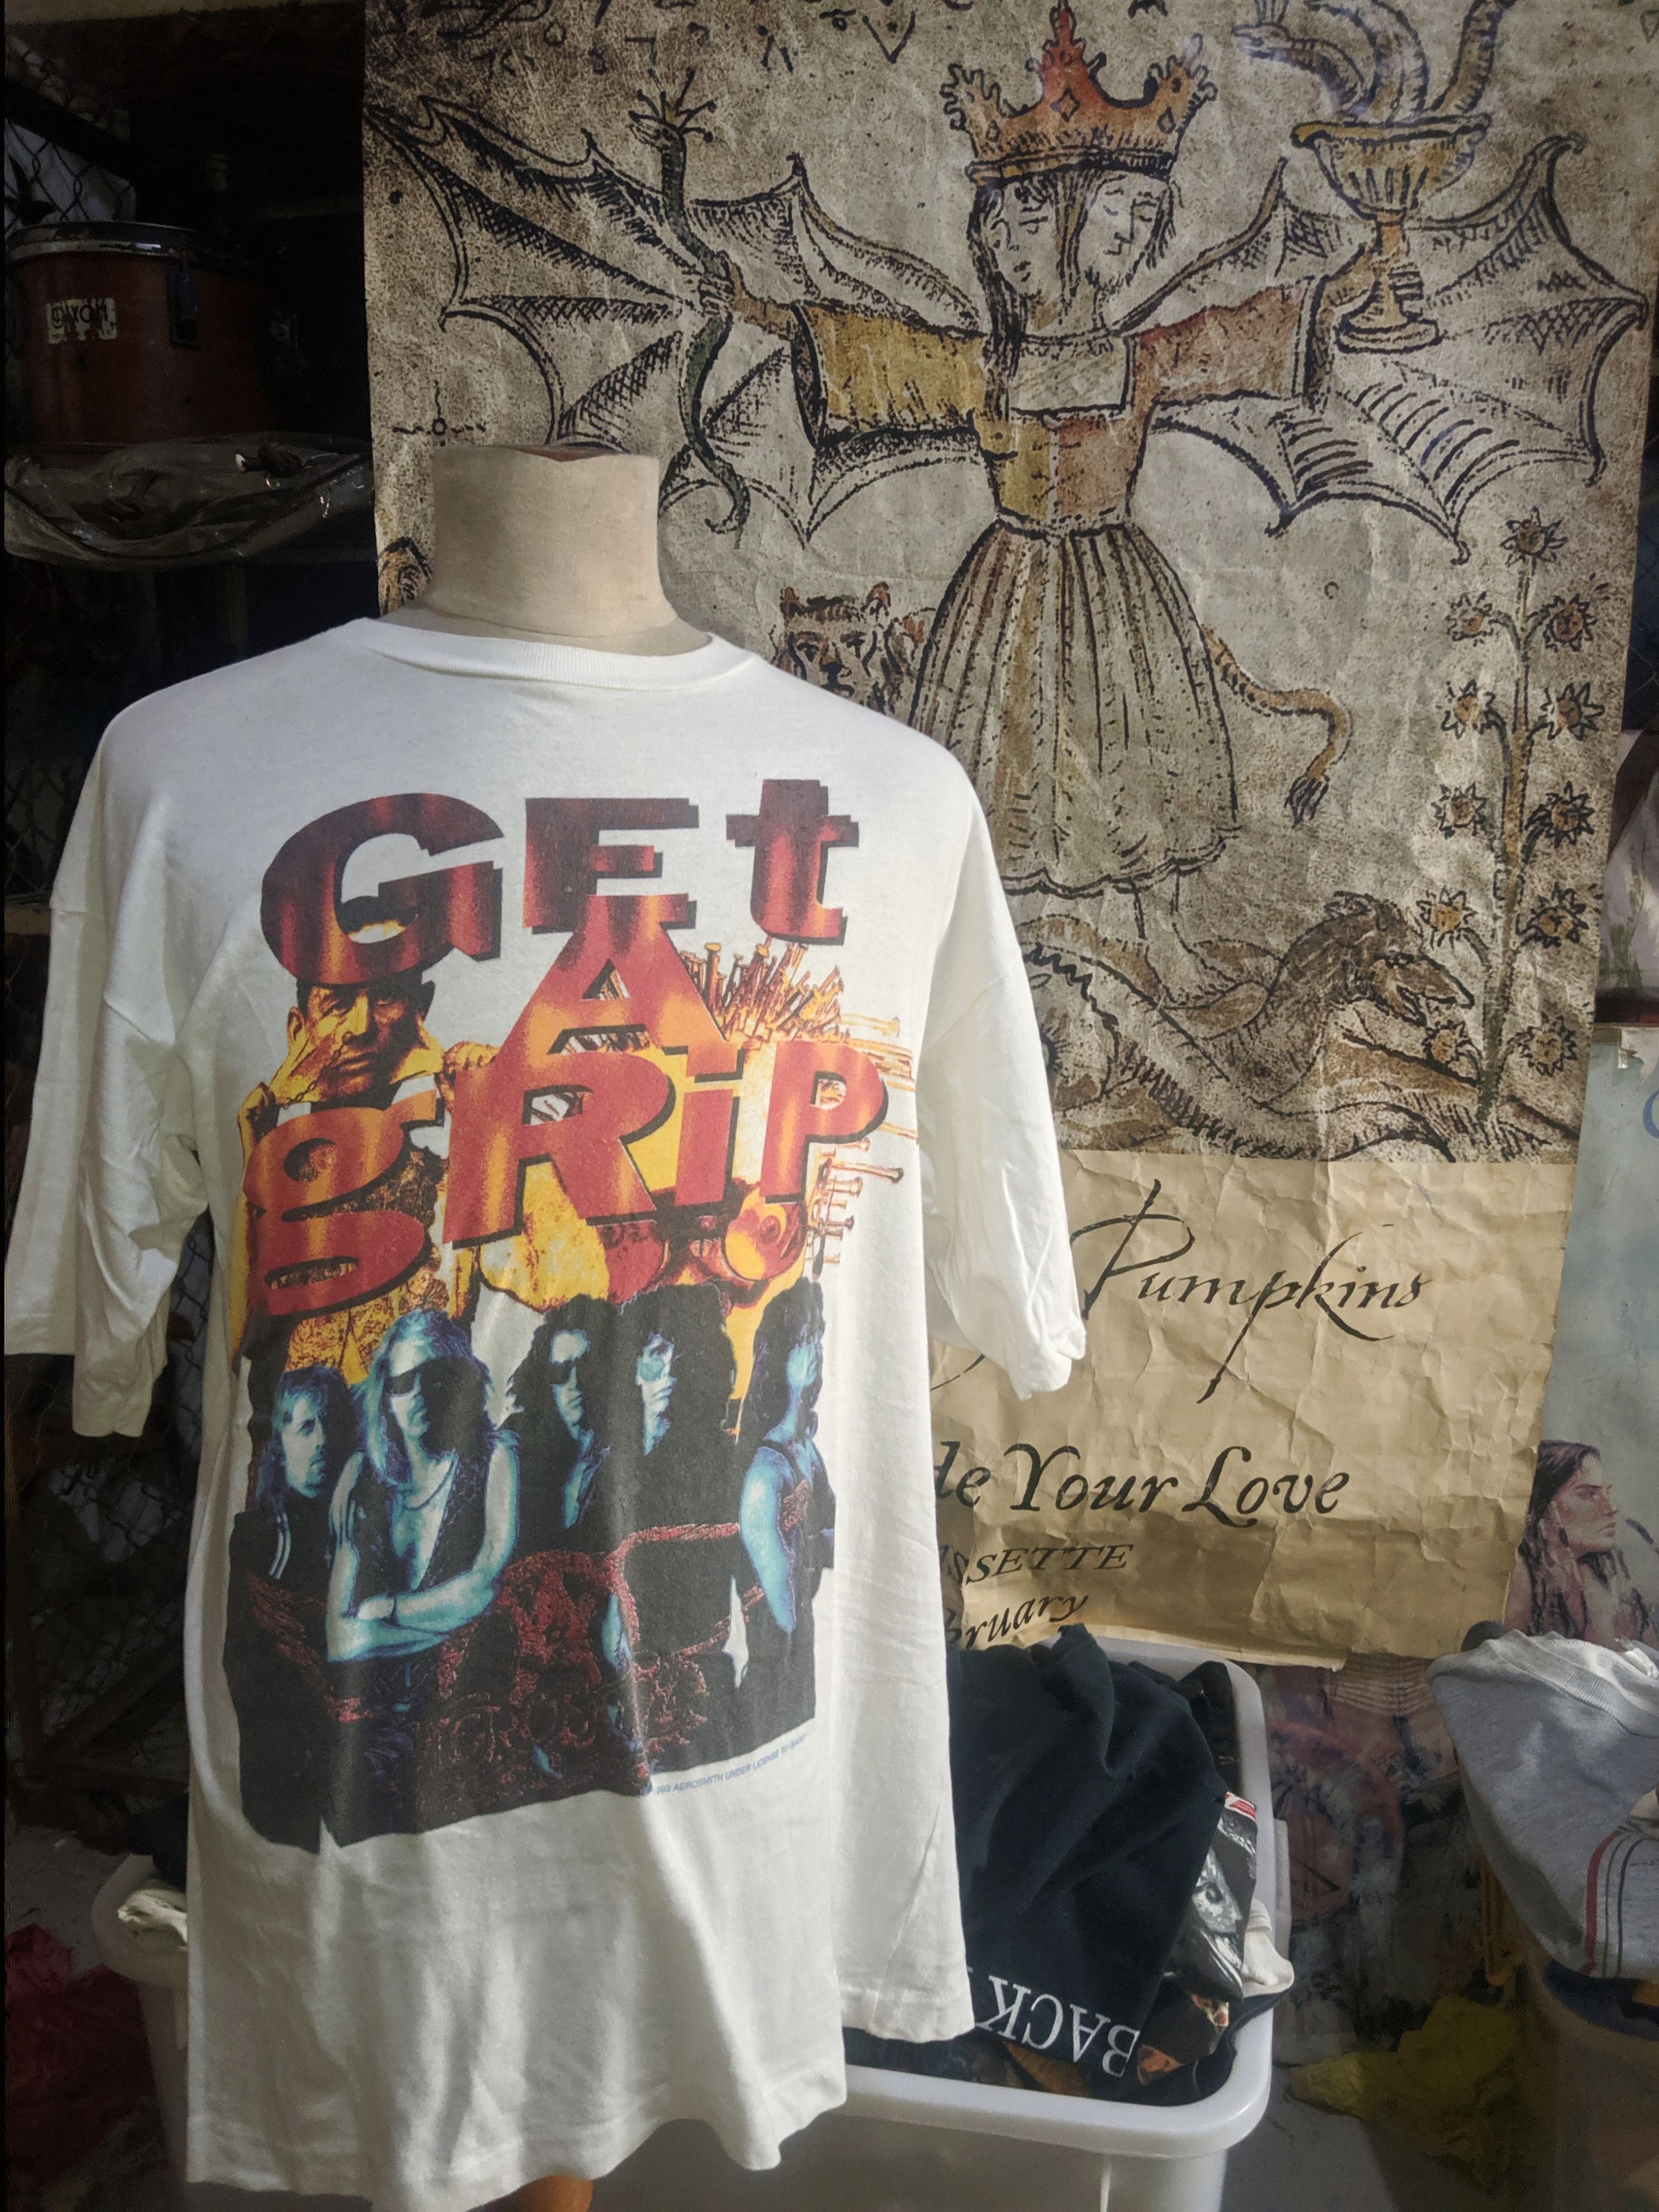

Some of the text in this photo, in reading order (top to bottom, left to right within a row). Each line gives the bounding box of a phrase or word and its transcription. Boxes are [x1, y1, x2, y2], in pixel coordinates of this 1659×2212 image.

[1069, 1179, 1434, 1404] Pumpkins
[1002, 1443, 1178, 1512] Your
[1184, 1445, 1350, 1529] Love
[976, 1976, 1139, 2077] BACK
